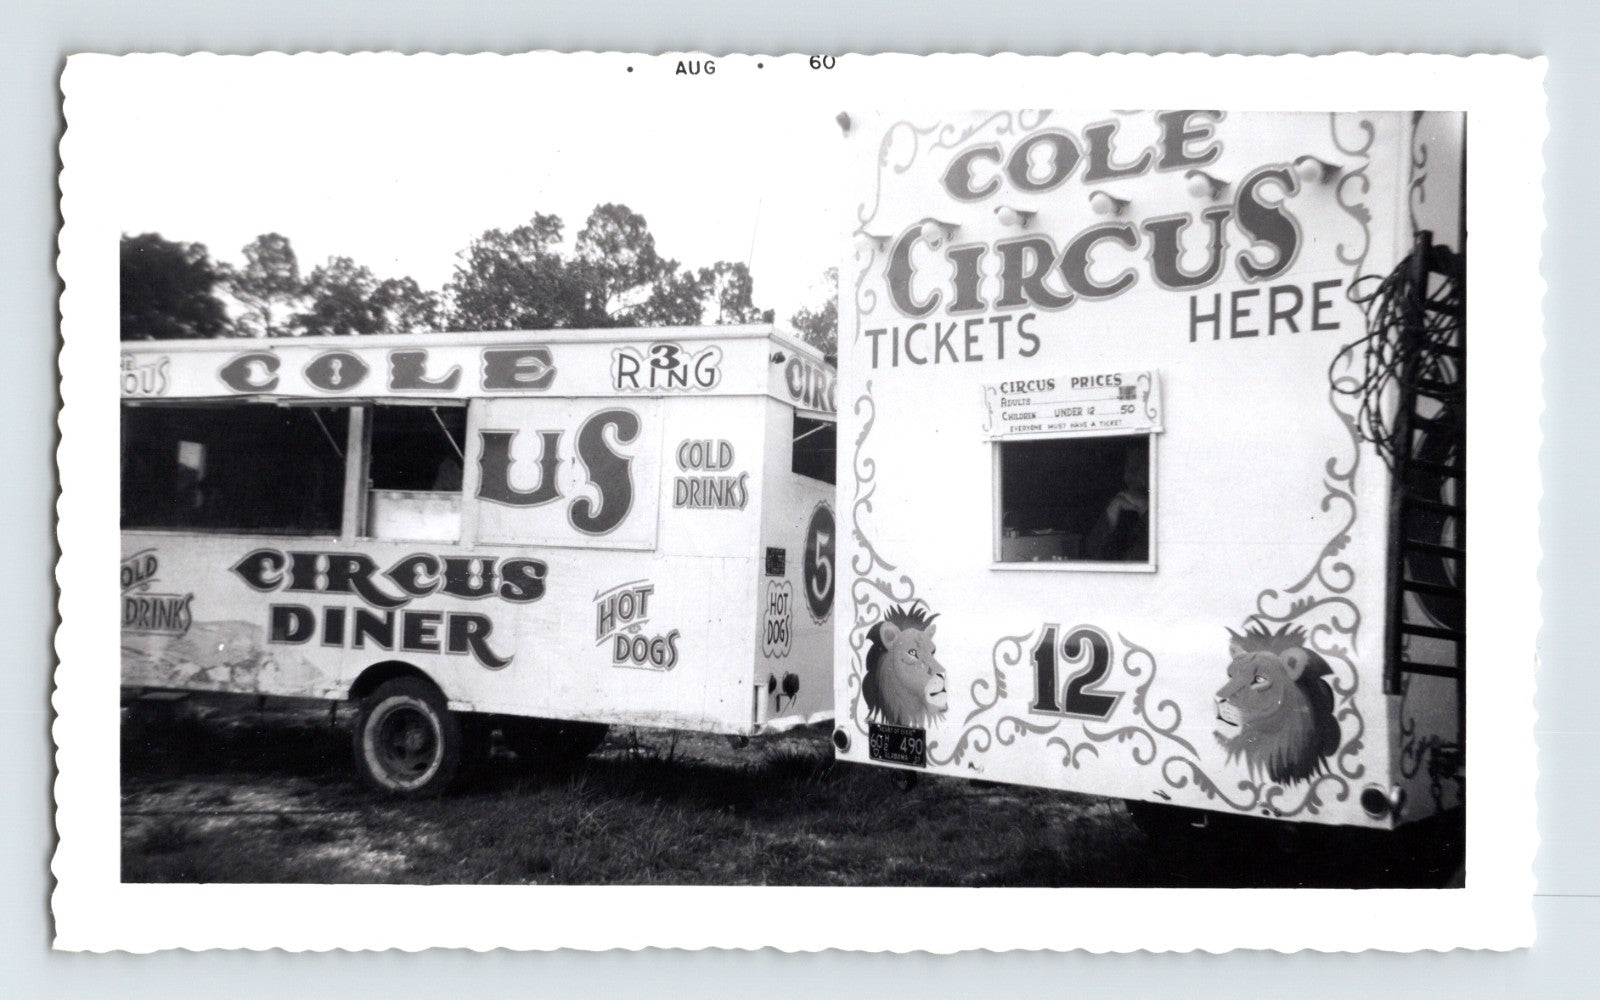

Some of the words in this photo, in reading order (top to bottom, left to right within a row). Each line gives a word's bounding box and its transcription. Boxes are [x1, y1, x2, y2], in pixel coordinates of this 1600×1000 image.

[939, 109, 1227, 203] COLE
[886, 163, 1303, 318] CIRCUS
[865, 313, 1041, 369] TICKETS
[1189, 279, 1343, 343] HERE
[219, 346, 557, 393] COLE
[617, 352, 716, 389] RING
[650, 345, 681, 370] 3
[1001, 378, 1056, 394] CIRCUS
[1071, 373, 1123, 388] PRICES
[1048, 422, 1066, 430] MUST
[1070, 420, 1088, 429] HAVE
[1054, 407, 1083, 418] UNDER
[1087, 406, 1096, 416] 12
[1120, 405, 1135, 415] 50
[475, 407, 641, 536] US
[675, 439, 735, 472] COLD
[672, 471, 750, 510] DRINKS
[228, 549, 548, 610] CIRCUS
[811, 533, 832, 600] 5
[124, 593, 194, 634] DRINKS
[596, 583, 655, 637] HOT
[769, 592, 789, 616] HOT
[267, 603, 515, 671] DINER
[612, 629, 681, 671] DOGS
[767, 615, 790, 647] DOGS
[1029, 623, 1126, 722] 12
[900, 737, 923, 755] 490
